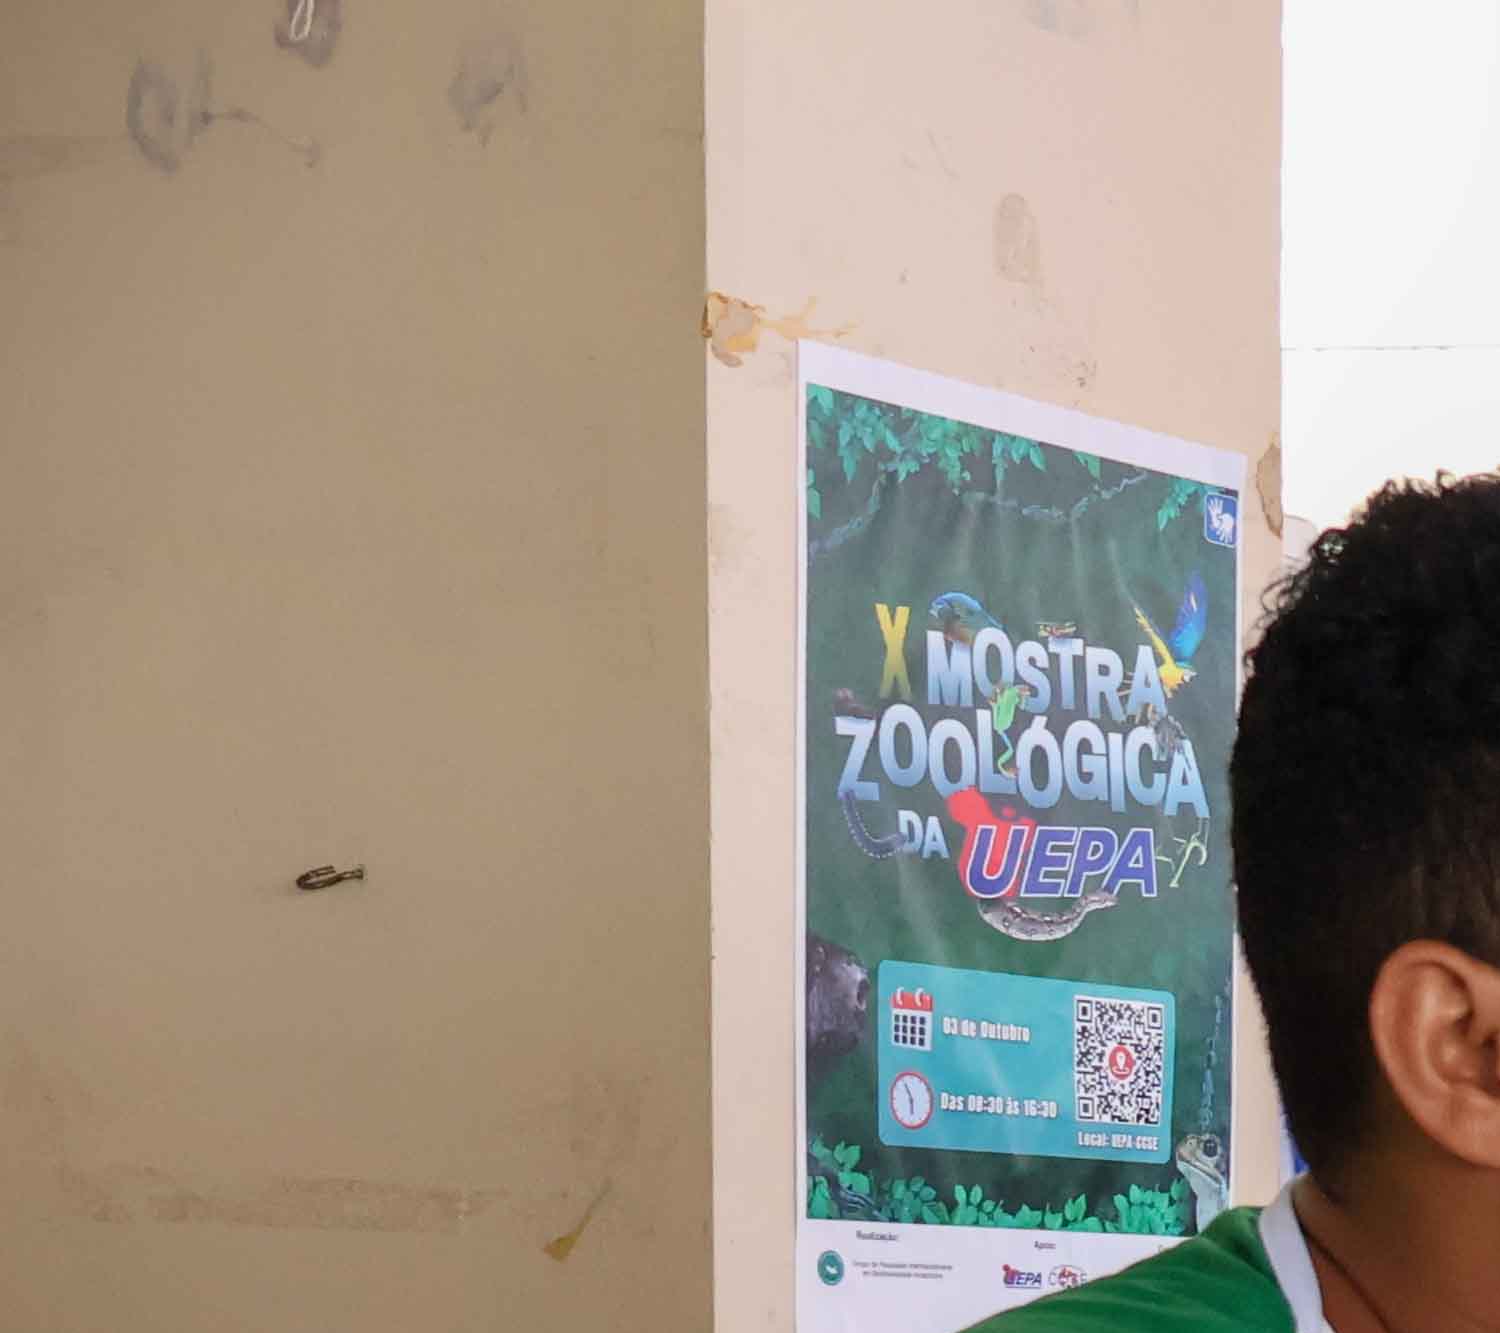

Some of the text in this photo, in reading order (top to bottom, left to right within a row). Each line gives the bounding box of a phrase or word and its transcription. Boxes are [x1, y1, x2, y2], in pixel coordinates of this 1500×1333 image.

[875, 603, 1168, 723] X MOSTRA
[835, 704, 1211, 819] ZOOLÓGICA
[899, 810, 1159, 899] DA UEPA
[960, 1020, 977, 1037] de
[941, 1092, 964, 1111] Das
[1023, 1099, 1057, 1118] 16:30
